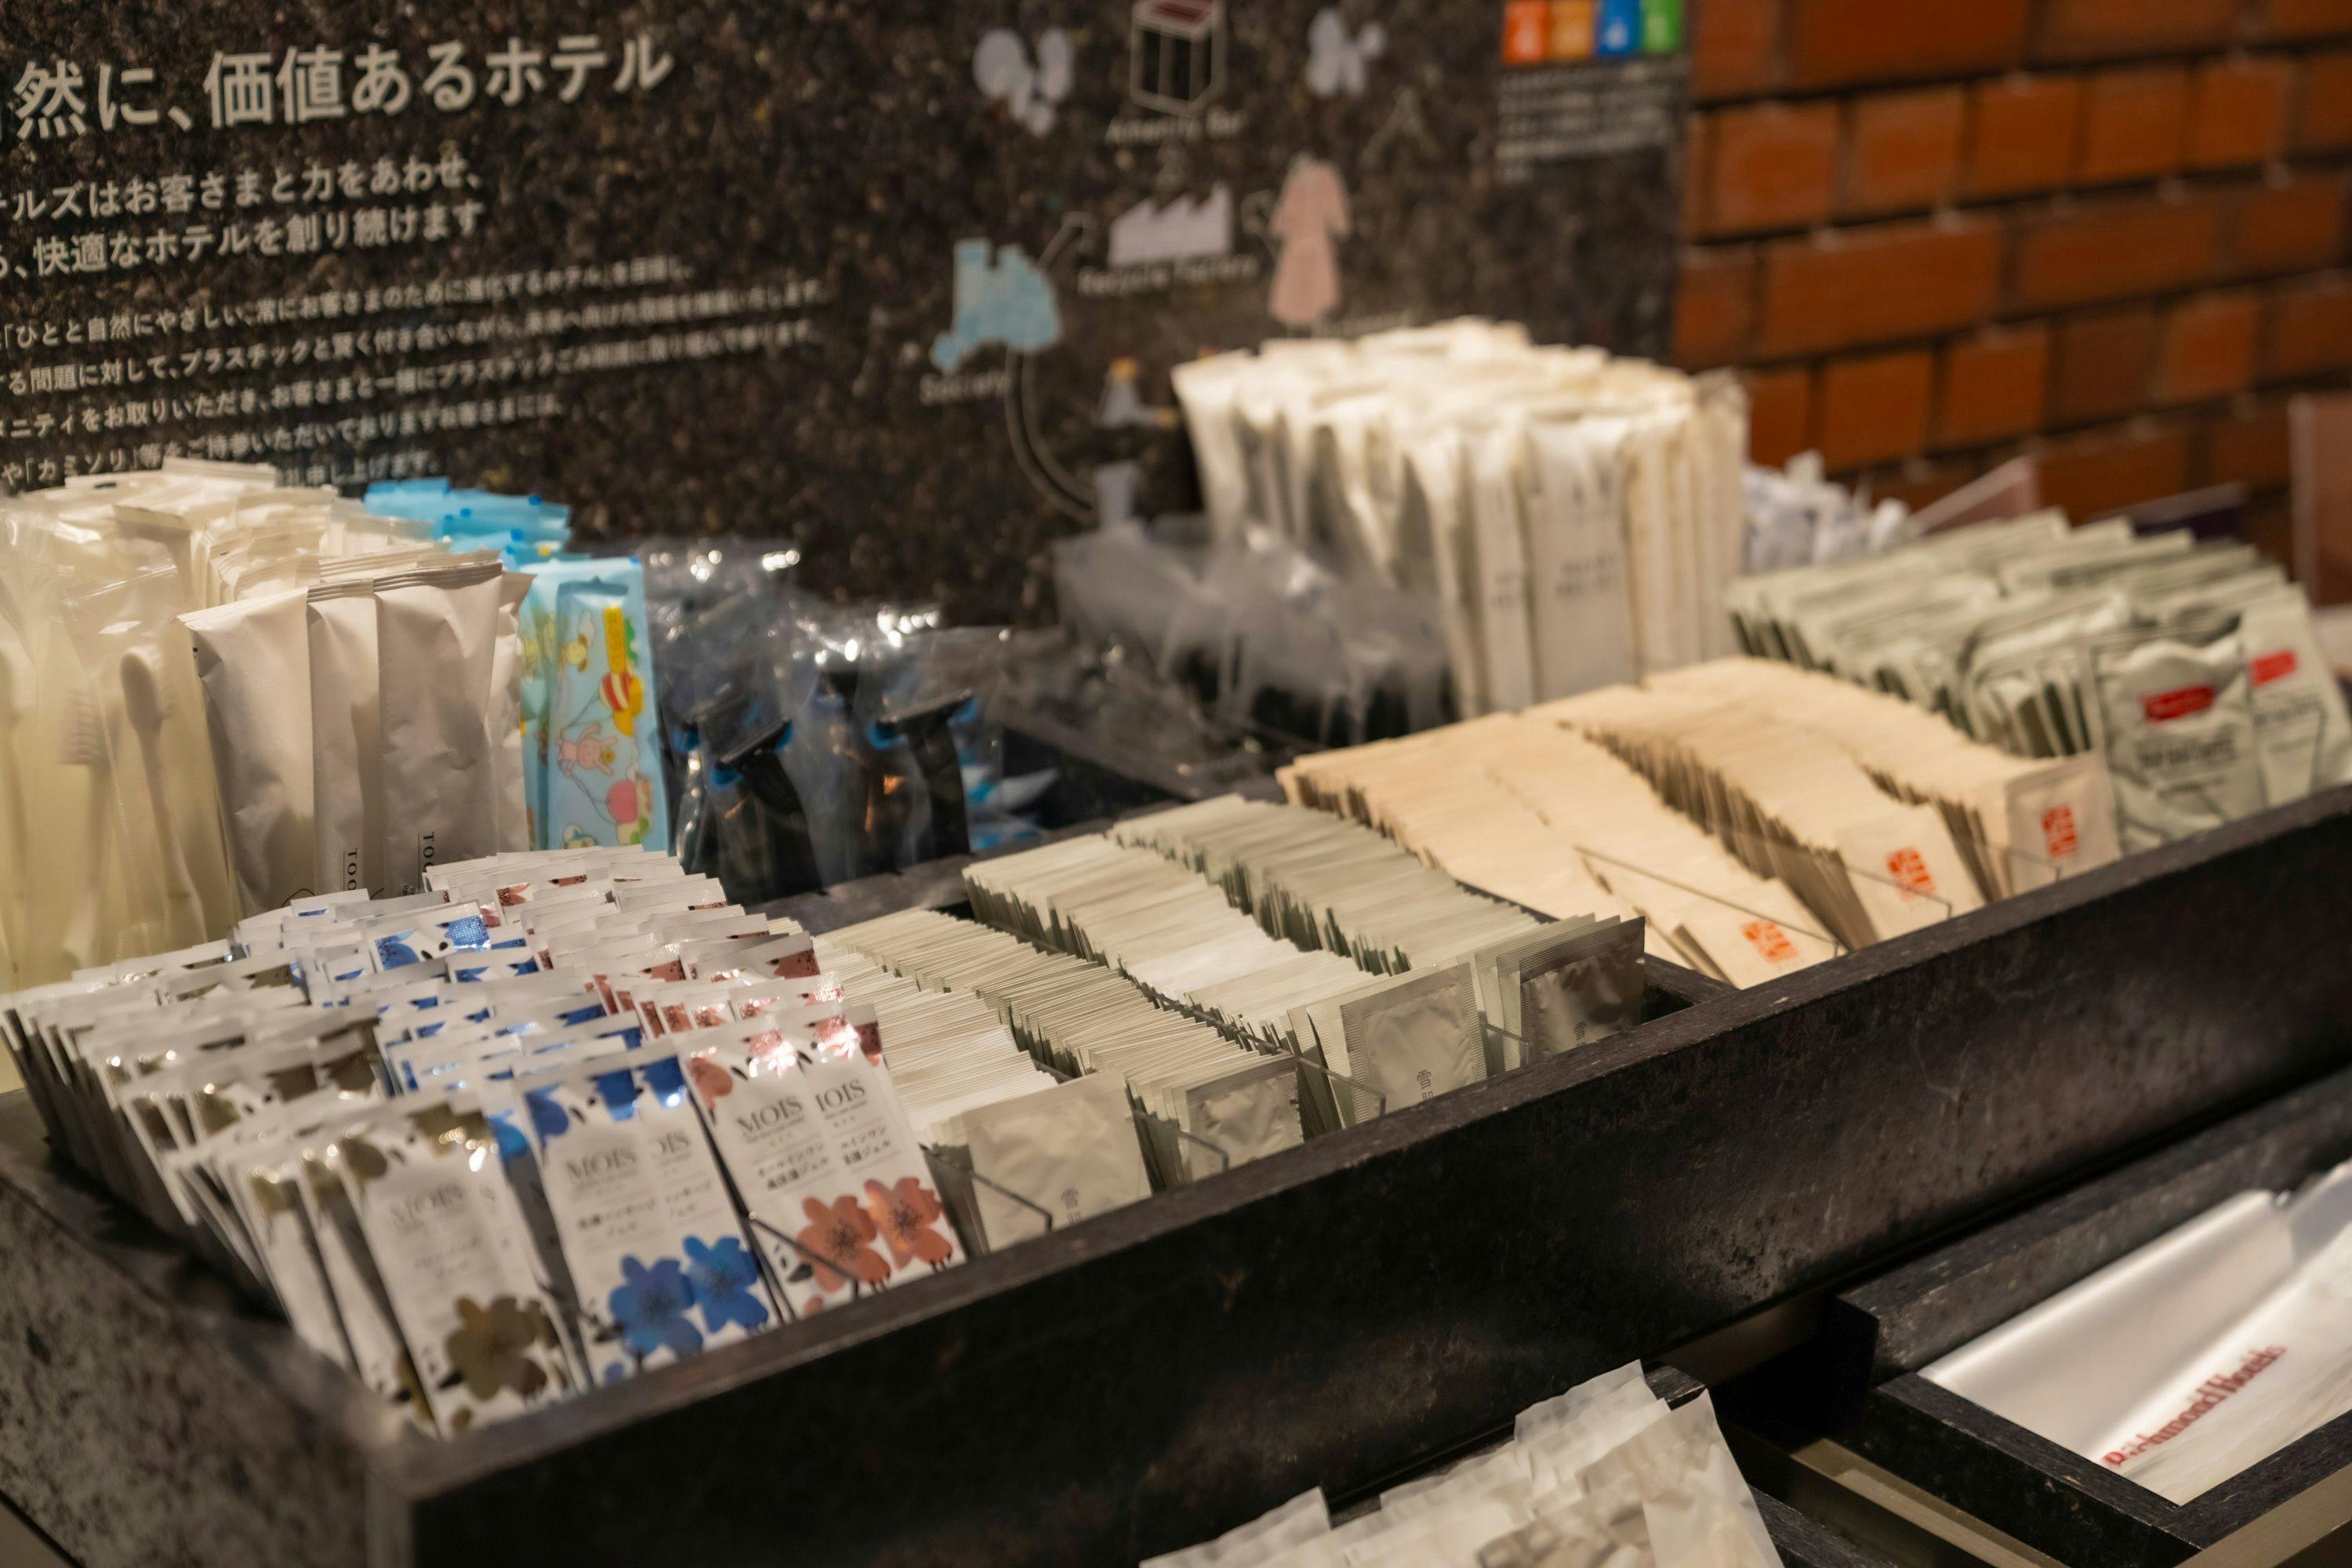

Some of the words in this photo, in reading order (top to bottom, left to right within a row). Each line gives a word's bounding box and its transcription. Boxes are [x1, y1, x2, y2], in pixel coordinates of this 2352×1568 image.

[13, 33, 675, 140] 然に、価値あるホテル
[736, 1095, 804, 1134] MOIS
[565, 1147, 637, 1178] MOIS
